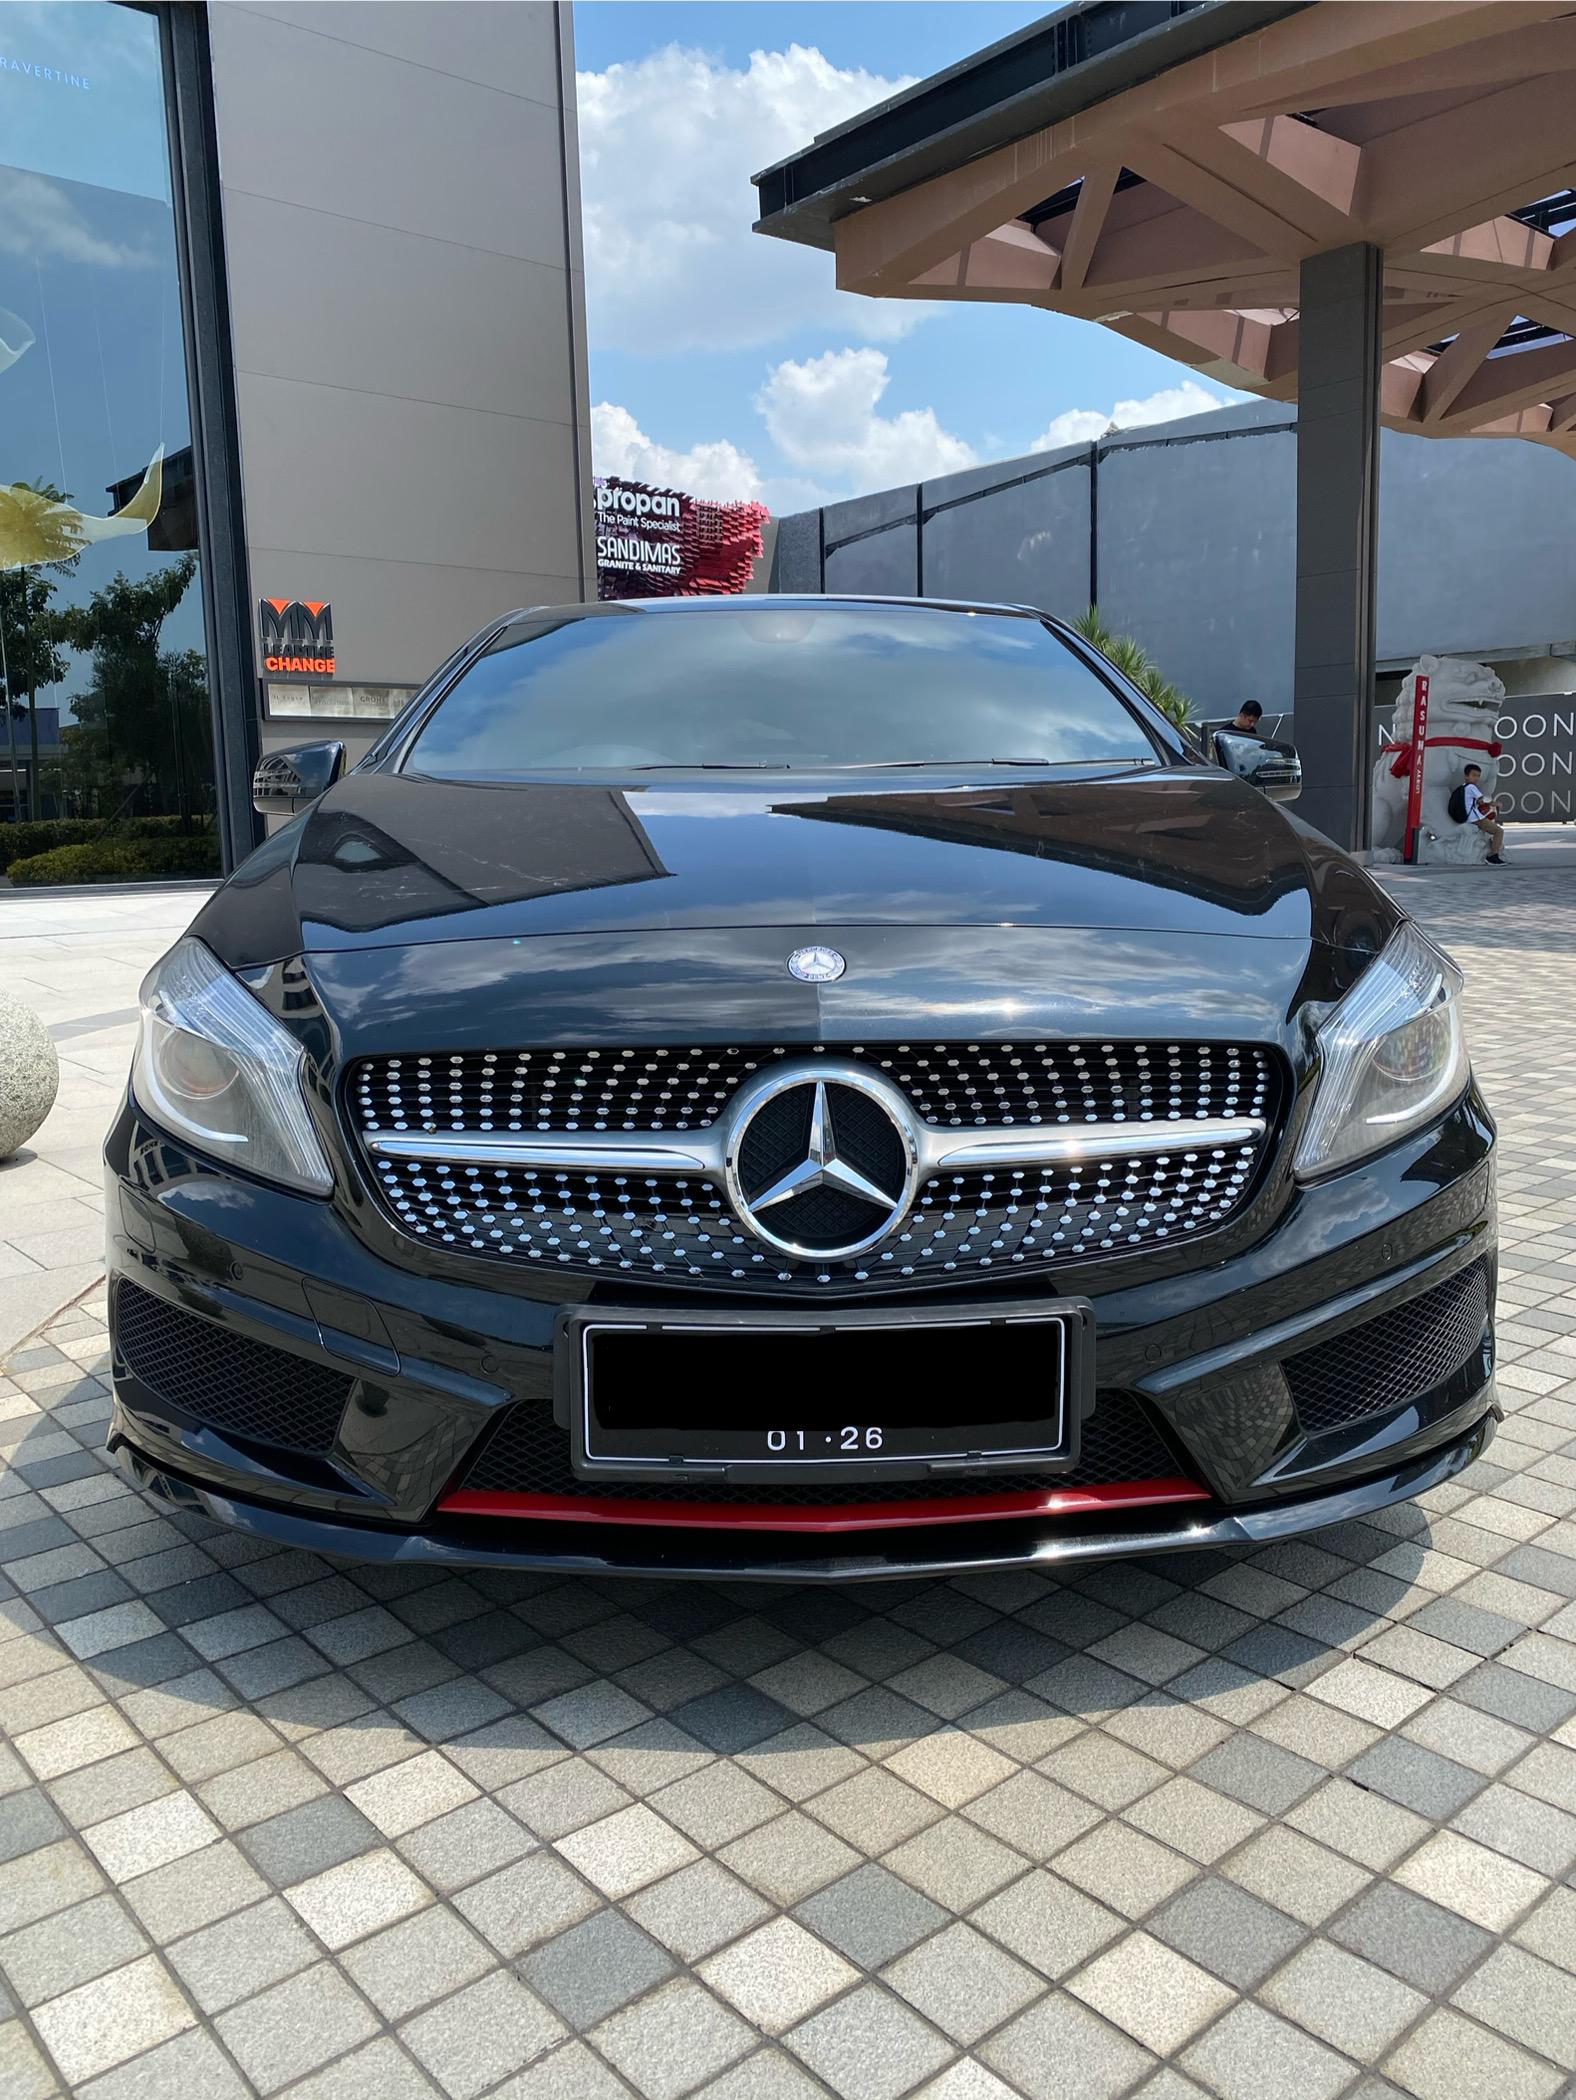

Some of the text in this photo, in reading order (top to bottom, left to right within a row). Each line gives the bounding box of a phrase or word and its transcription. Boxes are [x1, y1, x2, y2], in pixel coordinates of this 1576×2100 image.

[597, 487, 680, 517] propan
[598, 512, 681, 532] The Paint Specialist
[597, 536, 681, 565] SANDIMAS
[597, 558, 681, 575] GRANITE & SANITARY
[265, 656, 336, 674] CHANGE
[1416, 680, 1428, 766] RASUNA
